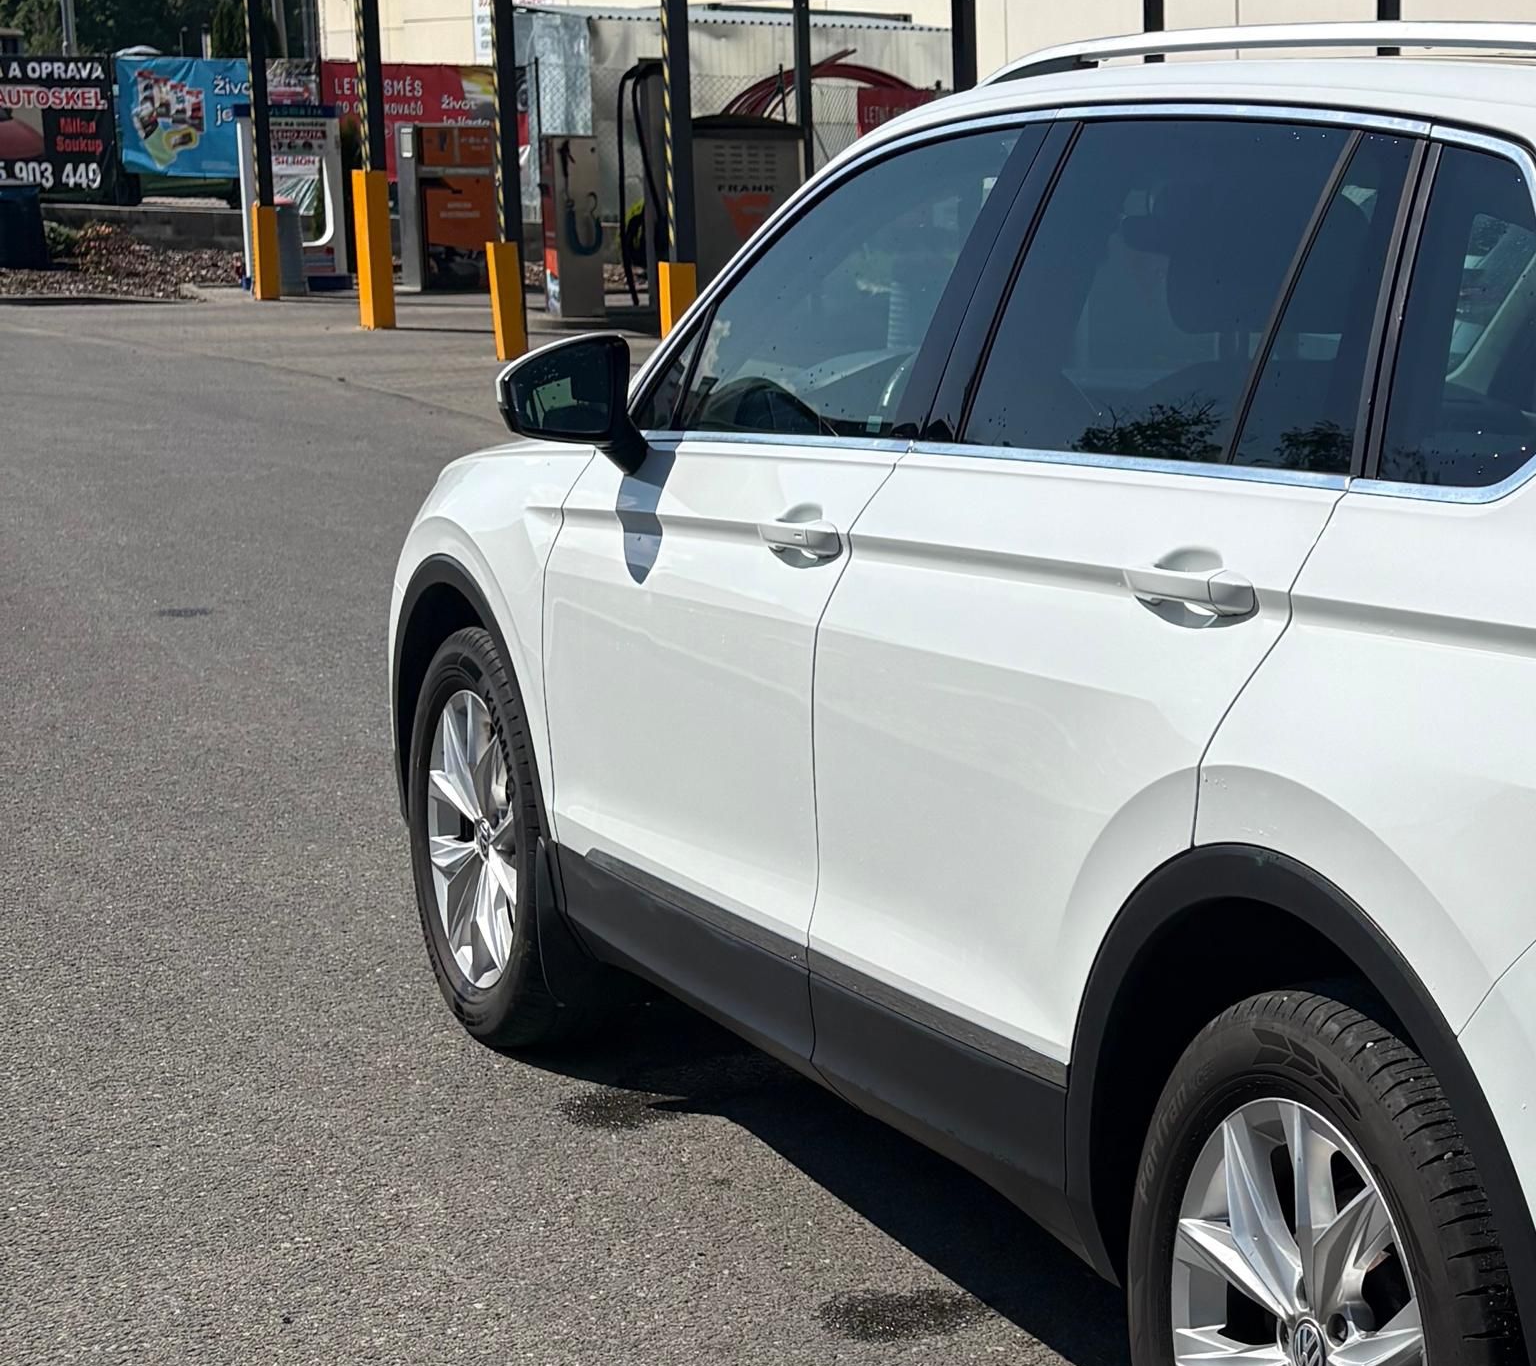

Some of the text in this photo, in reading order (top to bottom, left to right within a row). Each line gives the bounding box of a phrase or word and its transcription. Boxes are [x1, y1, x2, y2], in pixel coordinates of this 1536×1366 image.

[8, 61, 22, 79] A
[26, 61, 105, 80] OPRAVA
[213, 75, 250, 95] Živo
[383, 76, 423, 97] SMĚS
[56, 136, 103, 155] Soukup
[14, 160, 55, 189] 903
[62, 162, 102, 190] 449
[718, 184, 775, 193] FRANK
